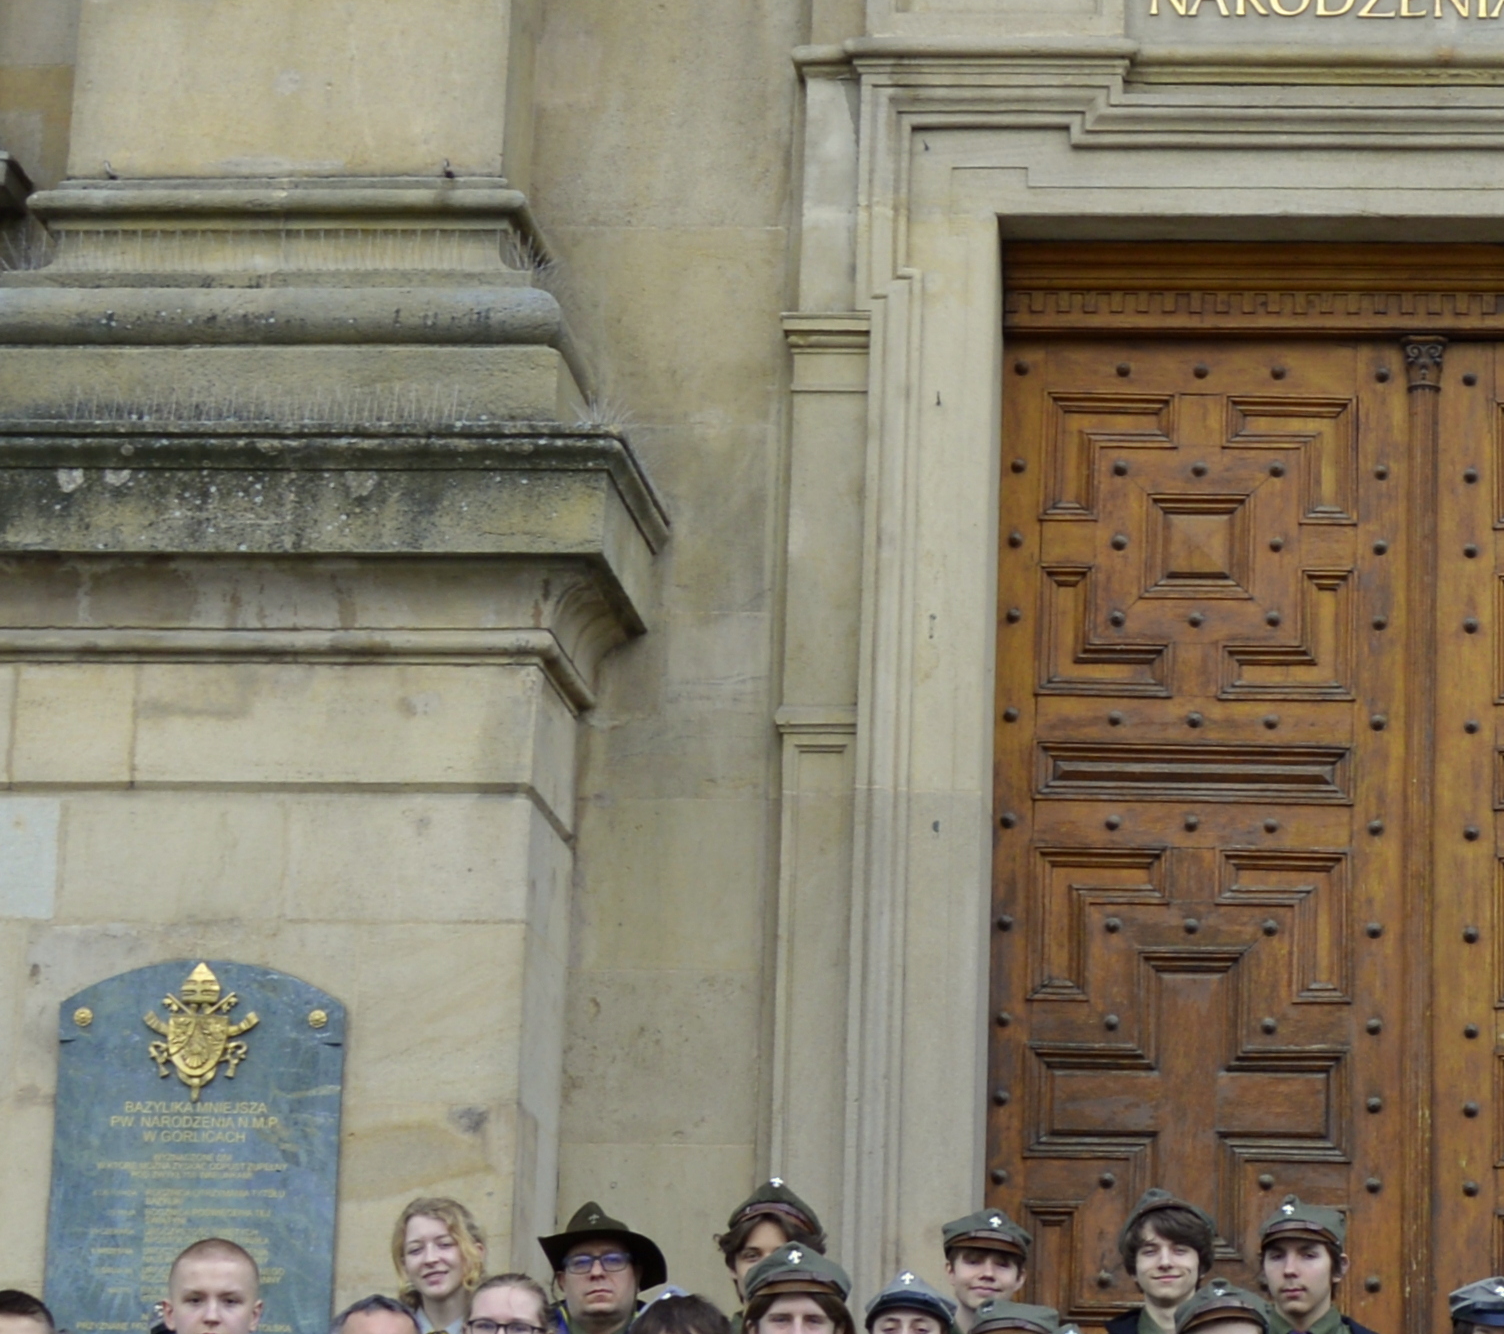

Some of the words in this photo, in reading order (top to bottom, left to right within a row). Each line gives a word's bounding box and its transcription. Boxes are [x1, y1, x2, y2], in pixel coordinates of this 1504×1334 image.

[124, 1101, 194, 1113] BAZYLIKA
[197, 1101, 268, 1114] MNIEJSZA
[140, 1116, 235, 1128] NARODZENIA
[143, 1130, 157, 1142] W
[161, 1130, 246, 1143] GORLICACH
